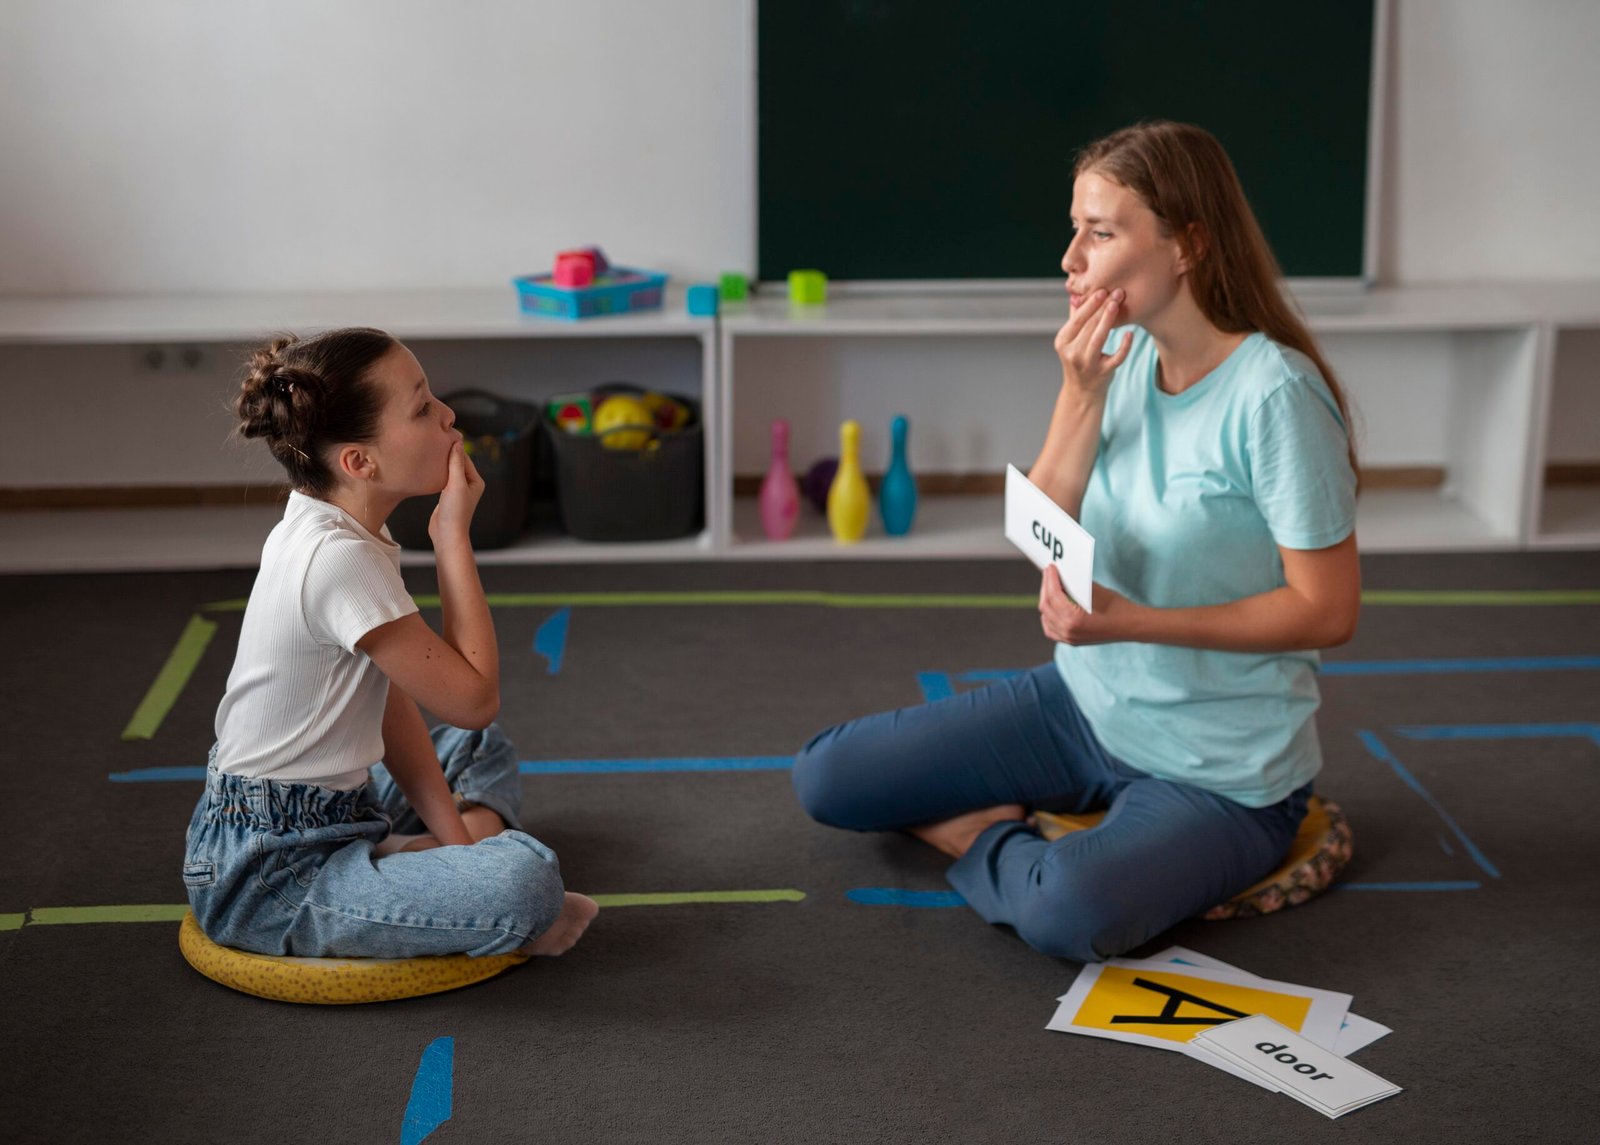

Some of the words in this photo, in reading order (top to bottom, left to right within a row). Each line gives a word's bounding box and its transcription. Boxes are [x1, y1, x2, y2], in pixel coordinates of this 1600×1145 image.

[1032, 519, 1064, 562] cup
[1110, 977, 1252, 1025] A
[1254, 1039, 1335, 1082] door
